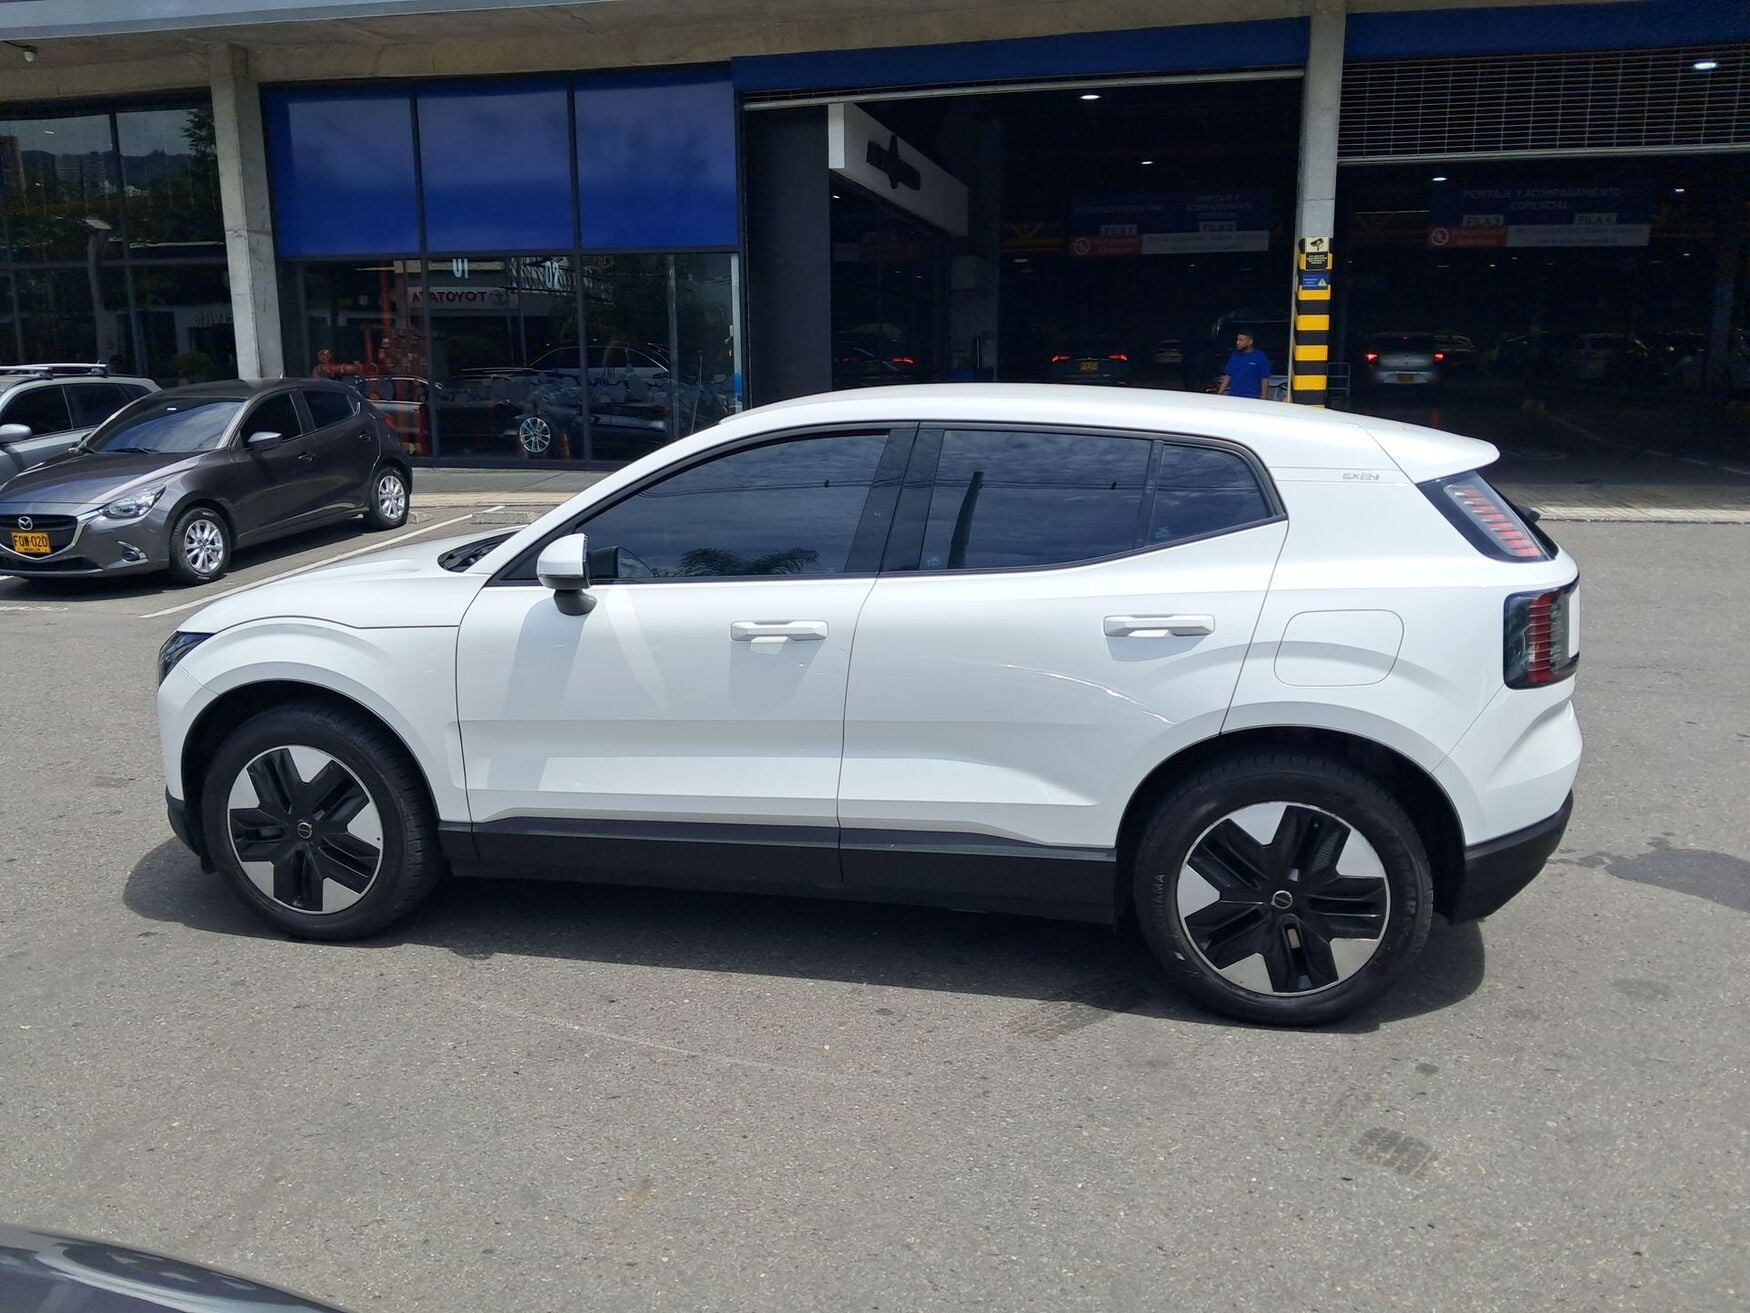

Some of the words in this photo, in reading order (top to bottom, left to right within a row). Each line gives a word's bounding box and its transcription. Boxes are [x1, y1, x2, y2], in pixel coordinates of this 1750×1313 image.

[1467, 216, 1490, 225] FILA
[1579, 215, 1603, 224] FILA
[1203, 223, 1225, 232] FILA
